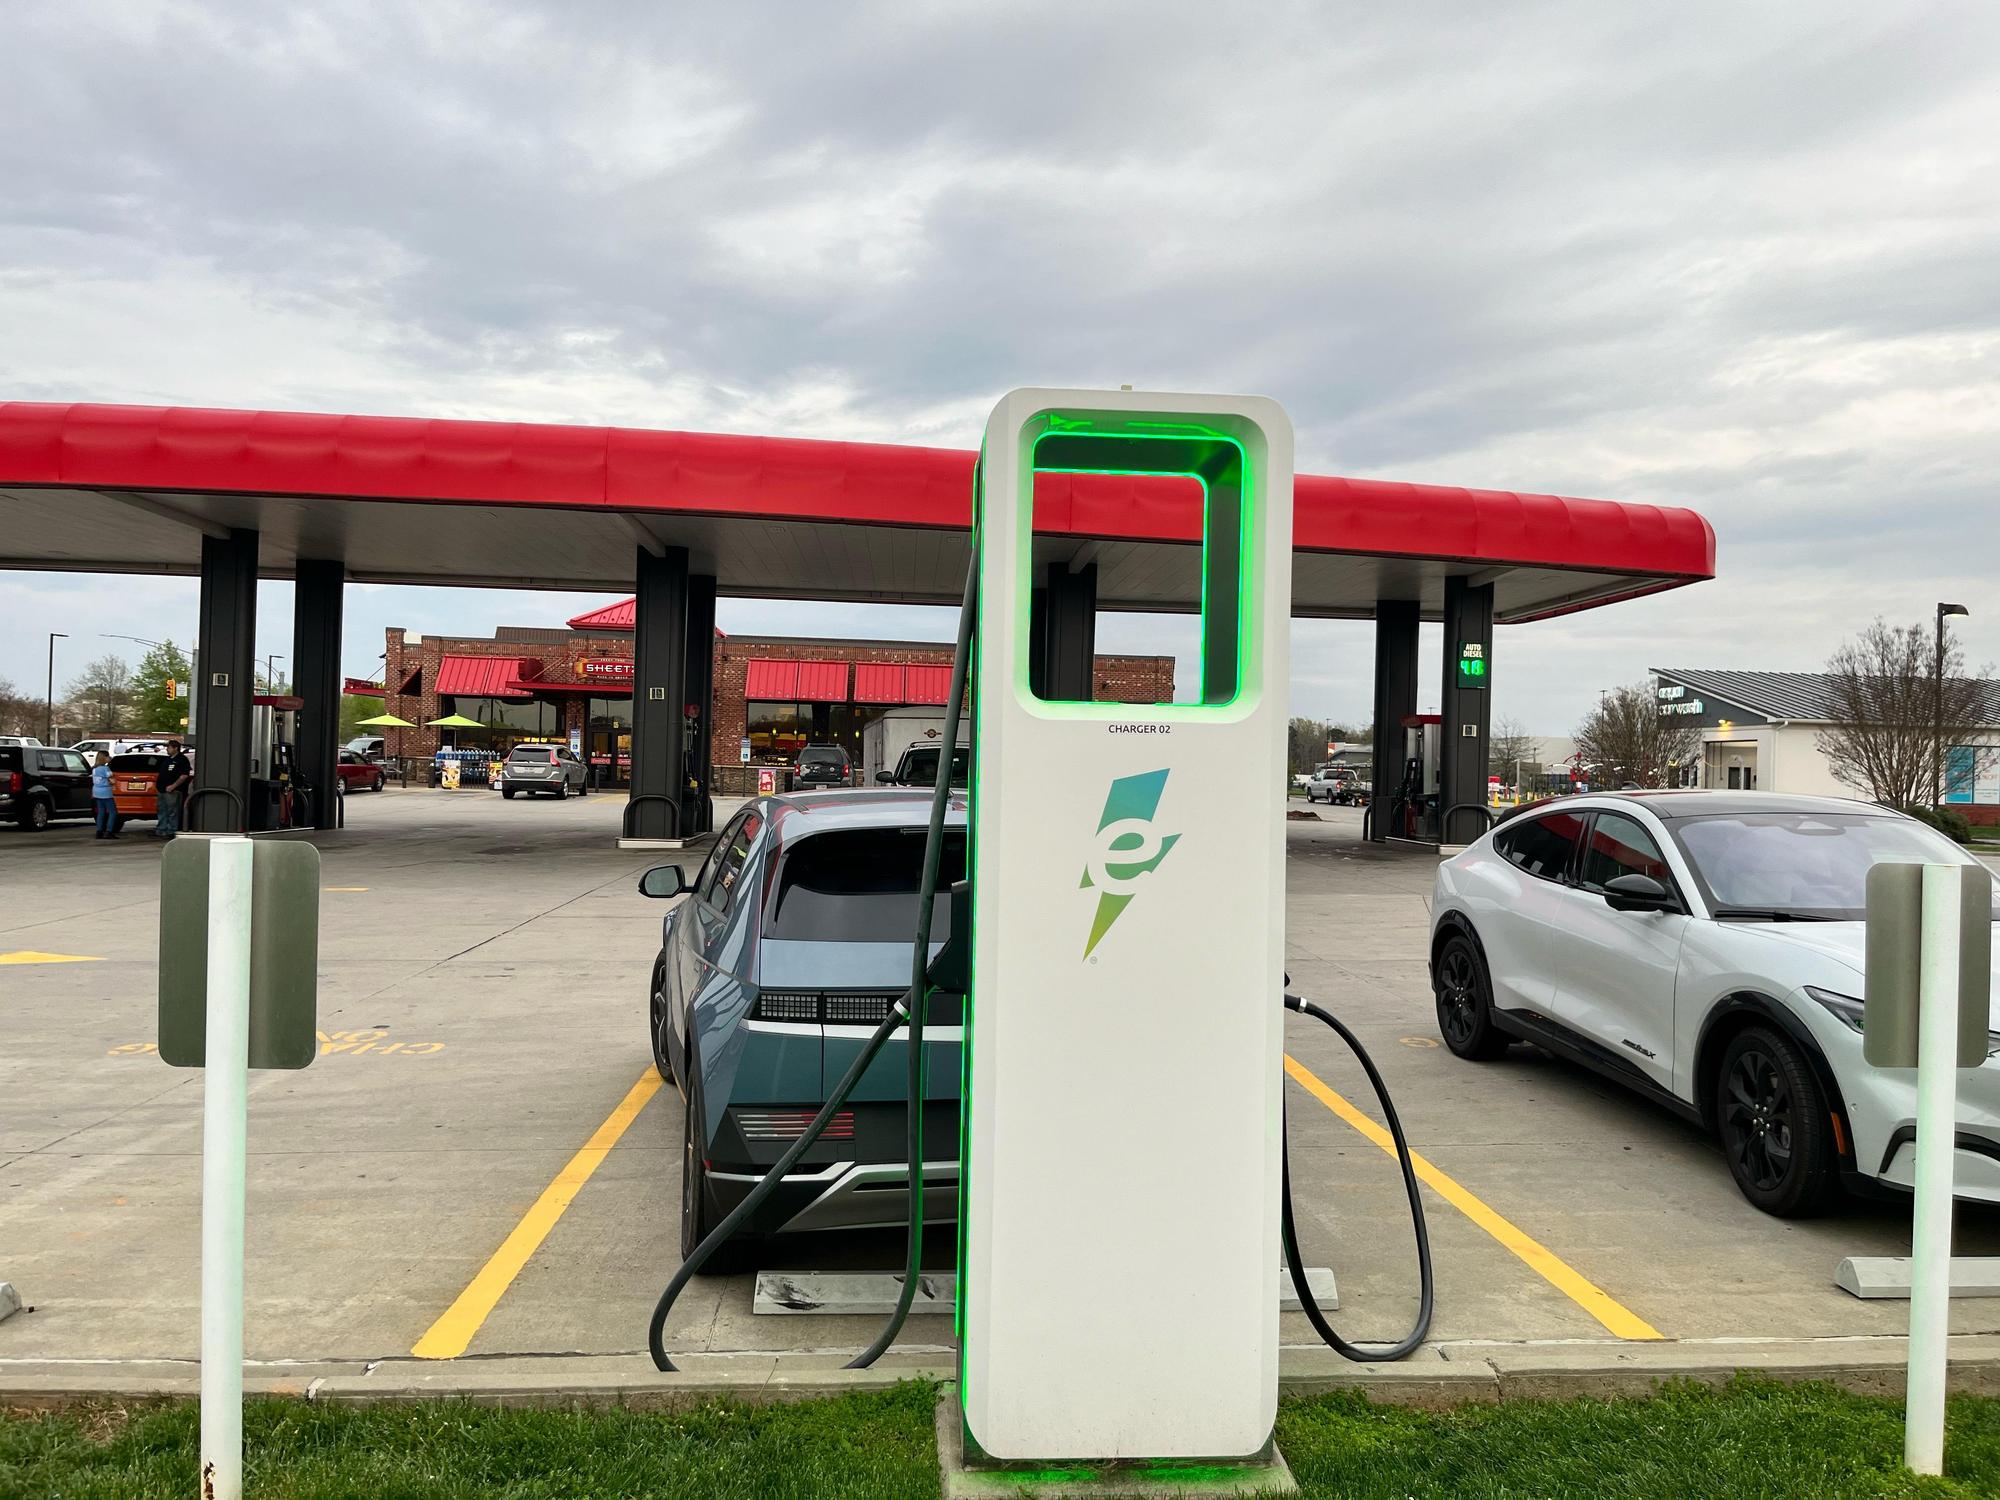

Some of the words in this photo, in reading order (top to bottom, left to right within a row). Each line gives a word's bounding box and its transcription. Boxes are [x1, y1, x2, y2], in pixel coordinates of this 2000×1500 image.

[1465, 643, 1482, 651] AUTO
[1463, 650, 1483, 658] DIESEL
[1108, 724, 1157, 734] CHARGER
[1158, 724, 1171, 734] 02
